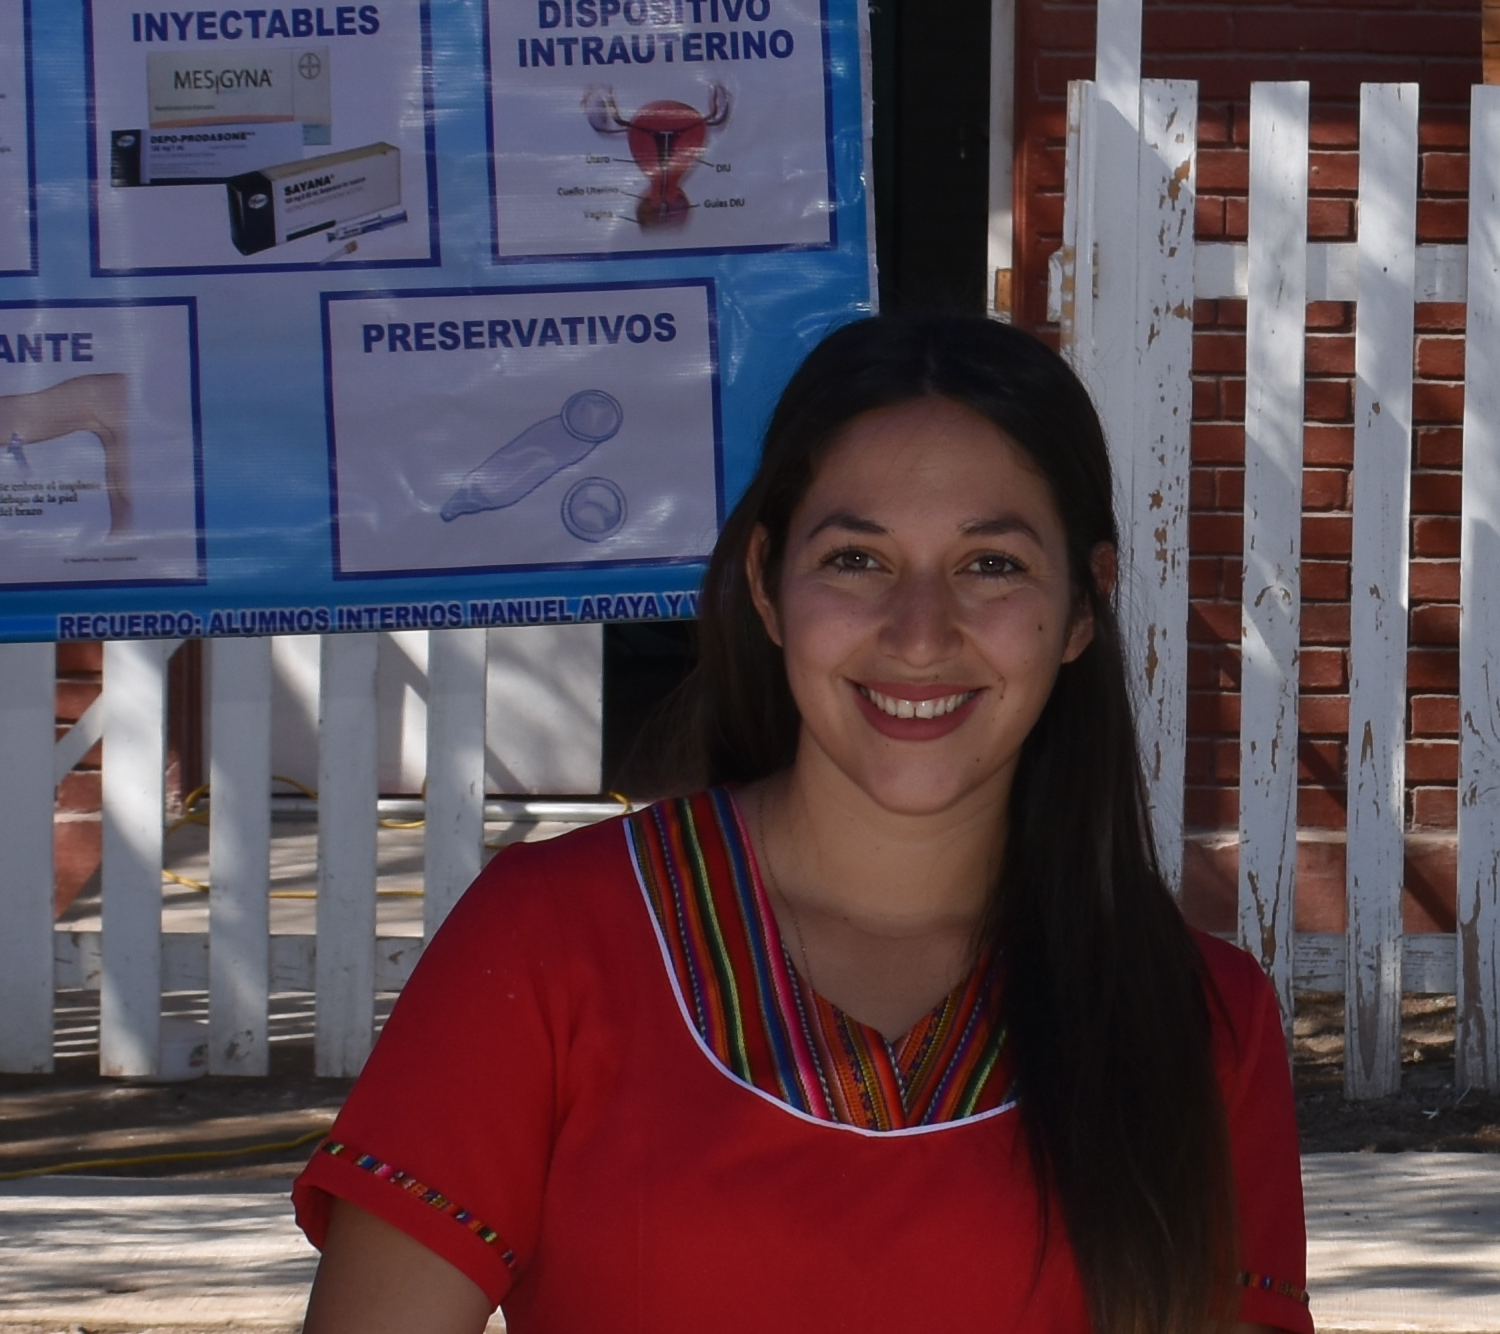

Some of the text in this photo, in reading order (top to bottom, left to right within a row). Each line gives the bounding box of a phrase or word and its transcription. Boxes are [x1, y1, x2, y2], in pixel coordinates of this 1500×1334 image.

[132, 5, 380, 41] INYECTABLES
[518, 29, 794, 67] INTRAUTERINO
[361, 313, 677, 354] PRESERVATIVOS
[58, 592, 682, 640] RECUERDO: ALUMNOS INTERNOS MANUEL ARAYA Y
